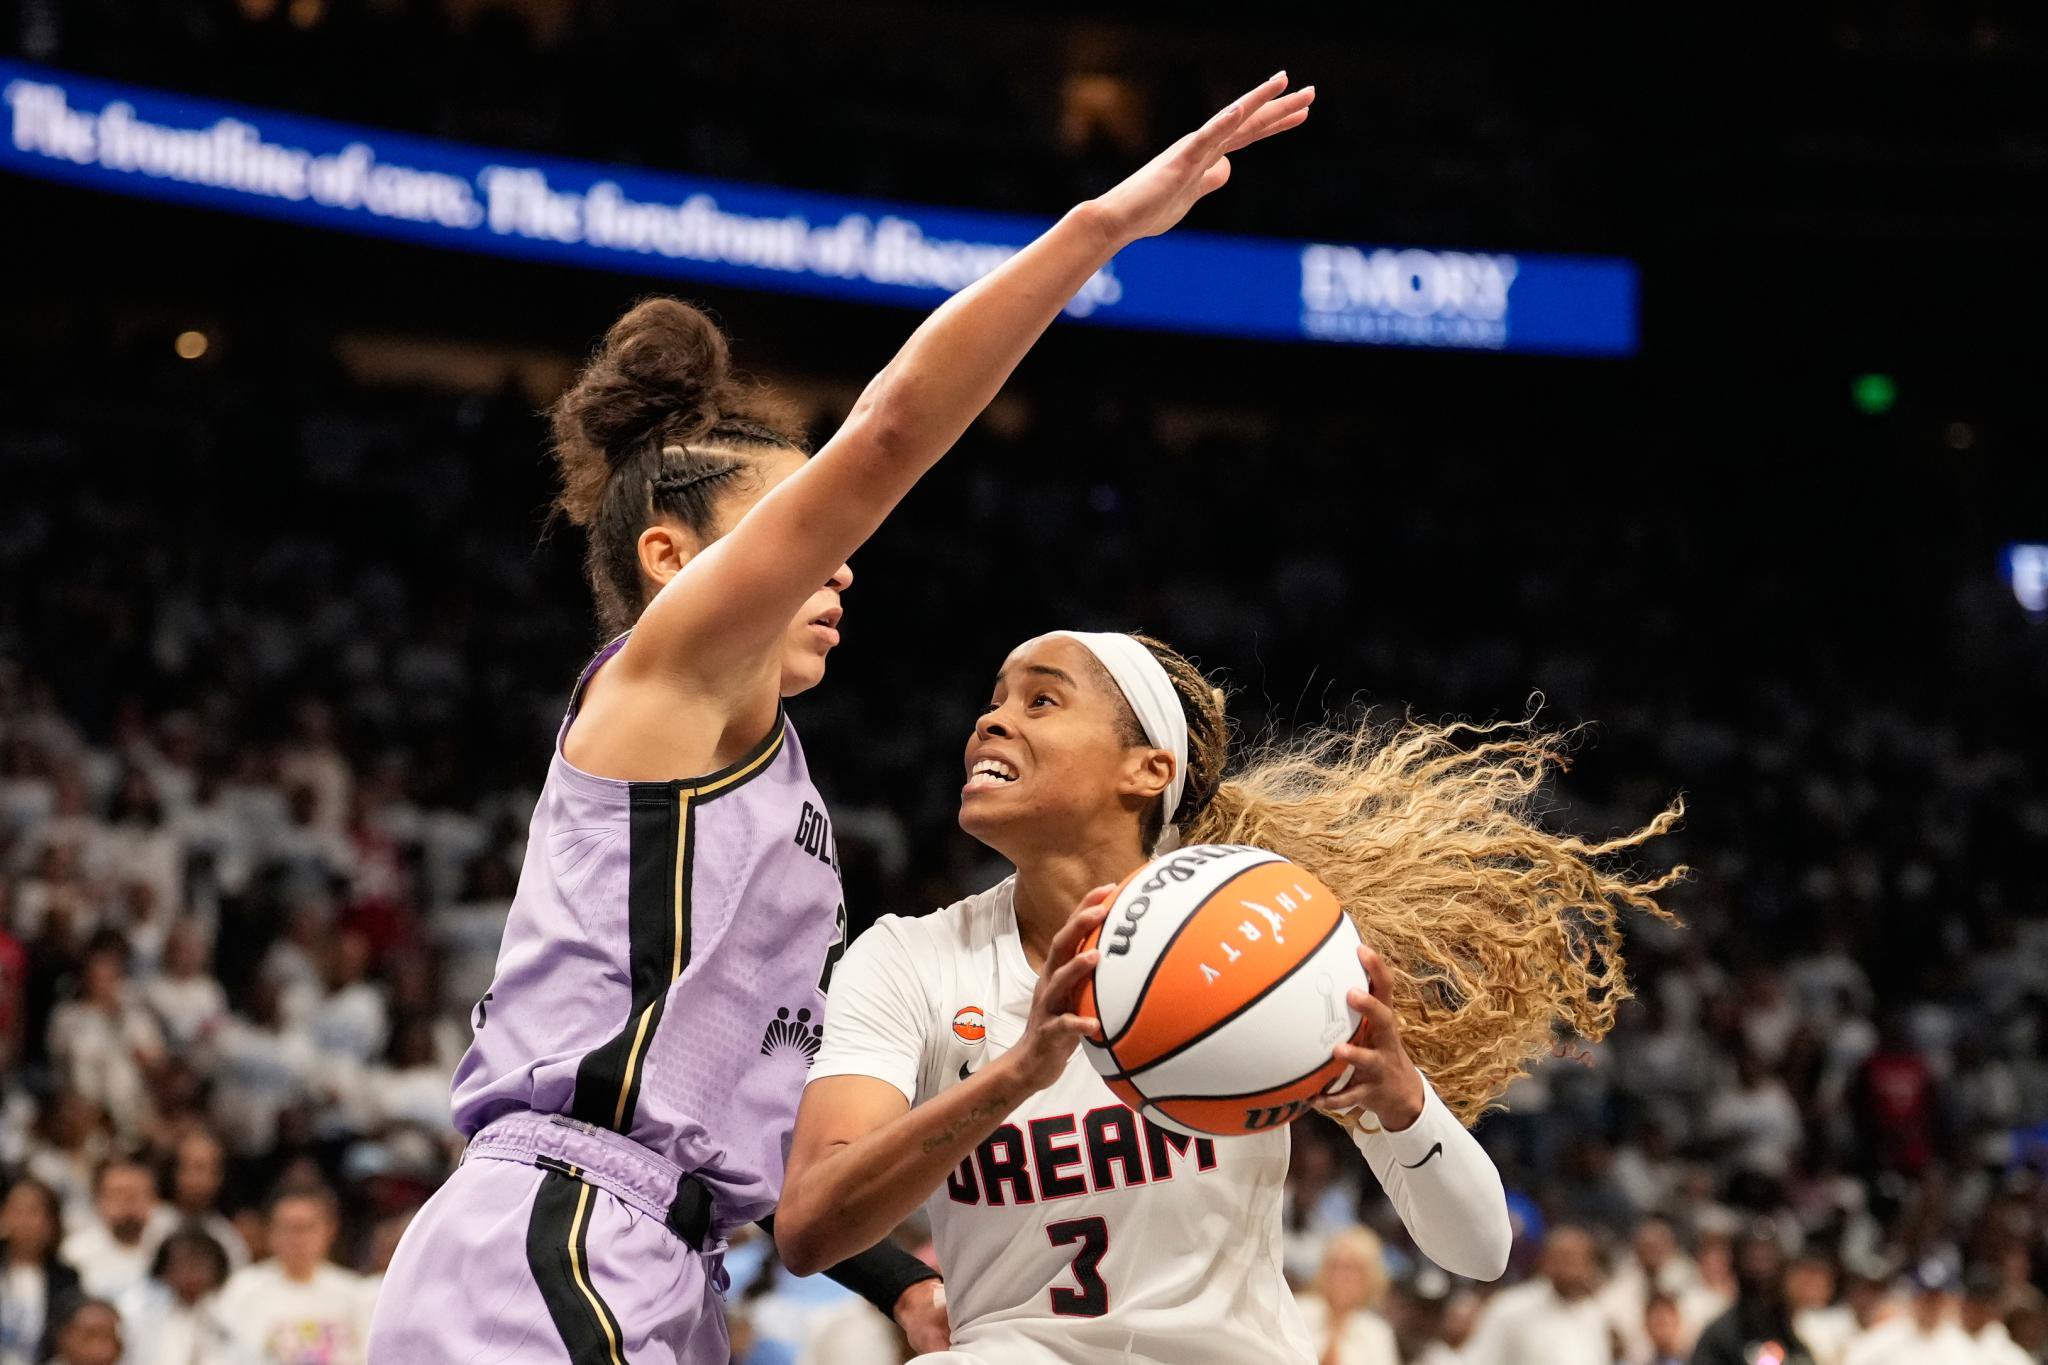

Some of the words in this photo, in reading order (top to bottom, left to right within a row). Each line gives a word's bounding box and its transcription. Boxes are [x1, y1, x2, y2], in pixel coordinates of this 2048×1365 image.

[6, 80, 98, 164] The
[98, 101, 309, 200] frontline
[309, 142, 374, 209] of
[477, 165, 583, 243] The
[583, 181, 808, 272] forefront
[808, 214, 872, 279] of
[1302, 244, 1517, 321] EMORY
[794, 800, 841, 885] GOL
[1046, 1216, 1109, 1318] 3
